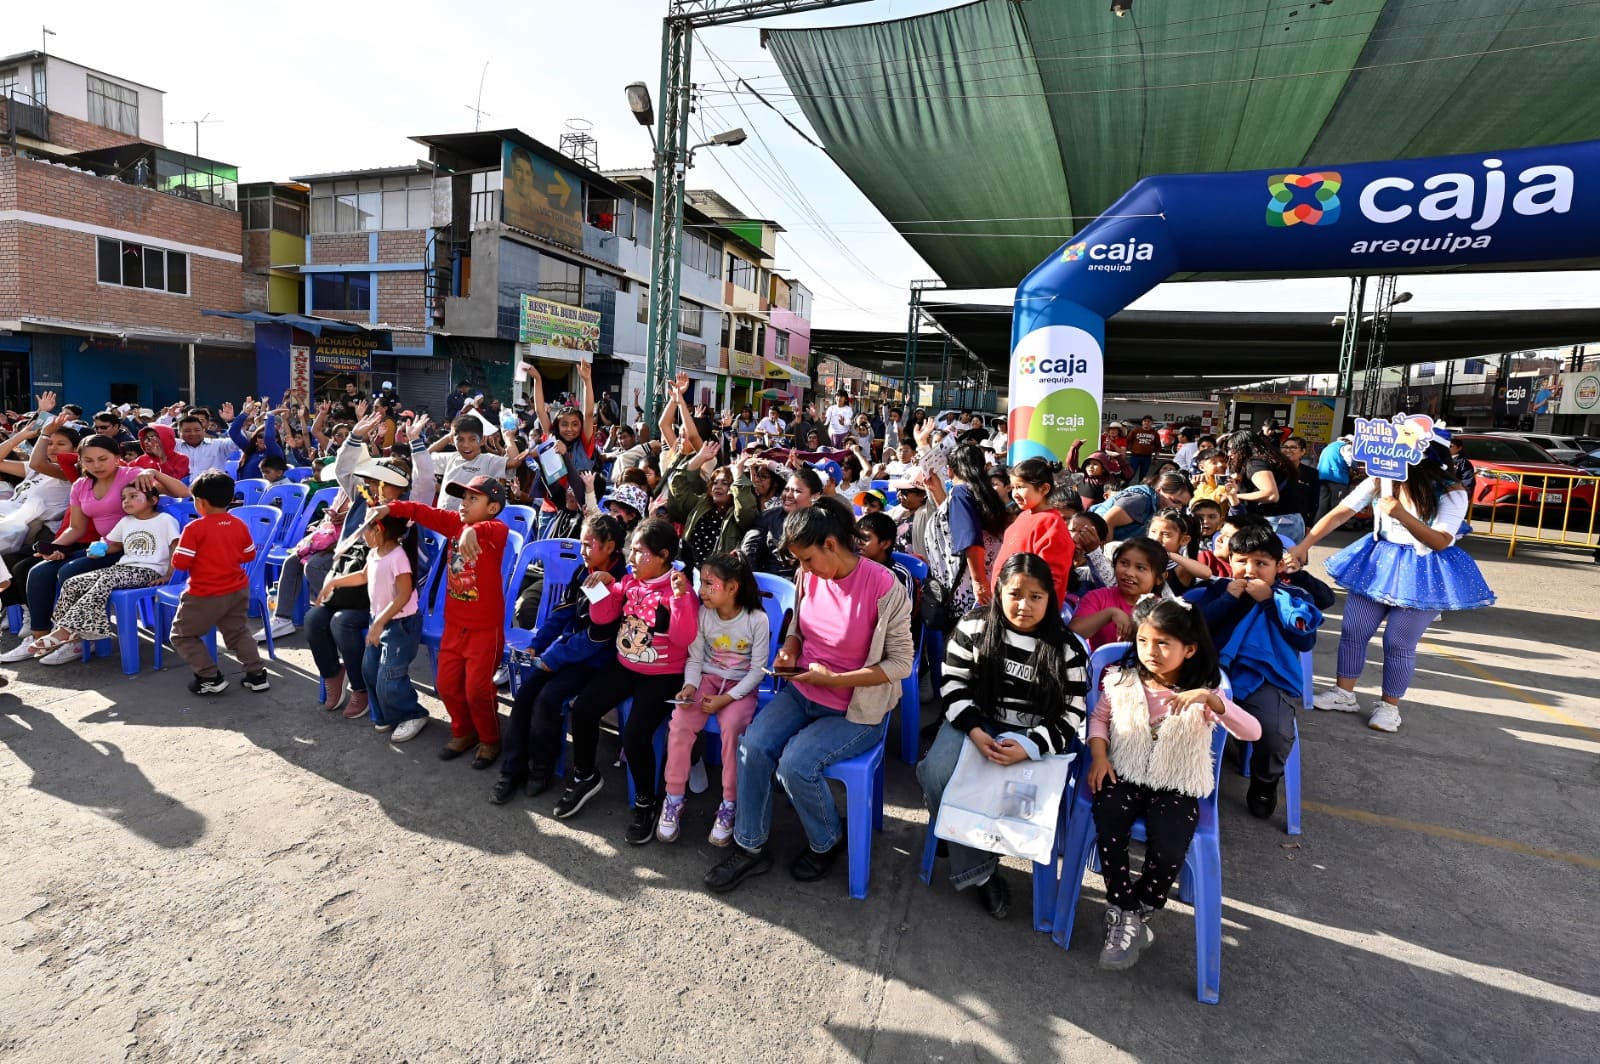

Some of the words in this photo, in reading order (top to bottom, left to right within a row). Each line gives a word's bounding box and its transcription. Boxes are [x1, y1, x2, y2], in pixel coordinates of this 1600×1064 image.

[1359, 158, 1574, 232] caja
[1350, 232, 1492, 255] arequipa
[1088, 238, 1154, 264] caja
[1088, 264, 1132, 273] arequipa
[560, 307, 578, 320] BUEN
[317, 347, 369, 357] ALARMAS
[1038, 354, 1087, 376] caja
[1038, 375, 1074, 384] arequipa
[1506, 385, 1526, 400] caja
[1056, 414, 1085, 428] caja
[1358, 422, 1392, 436] Brilla
[1355, 436, 1418, 460] Navidad
[1380, 458, 1398, 468] caja
